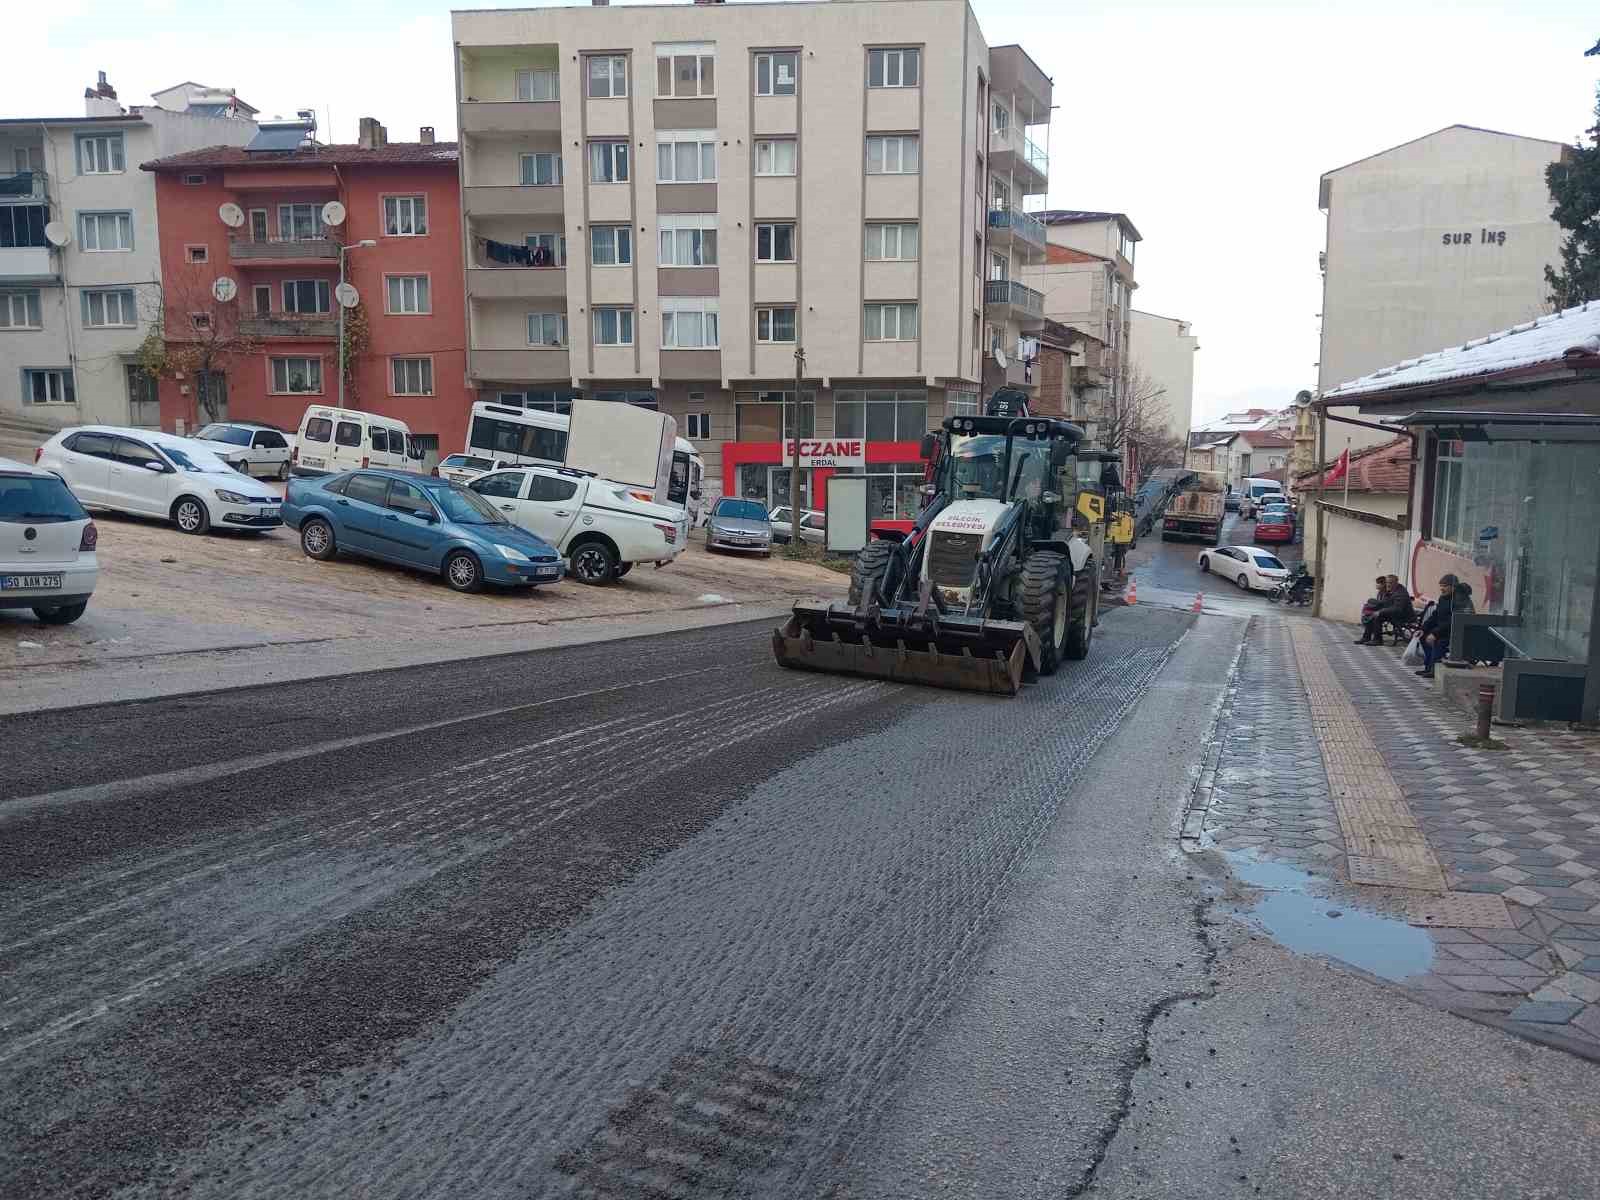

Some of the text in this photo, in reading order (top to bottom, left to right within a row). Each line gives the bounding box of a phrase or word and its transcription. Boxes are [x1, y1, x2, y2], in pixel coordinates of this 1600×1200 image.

[1442, 228, 1507, 246] SUR İNŞ
[787, 441, 861, 457] ECZANE
[43, 575, 59, 587] 275
